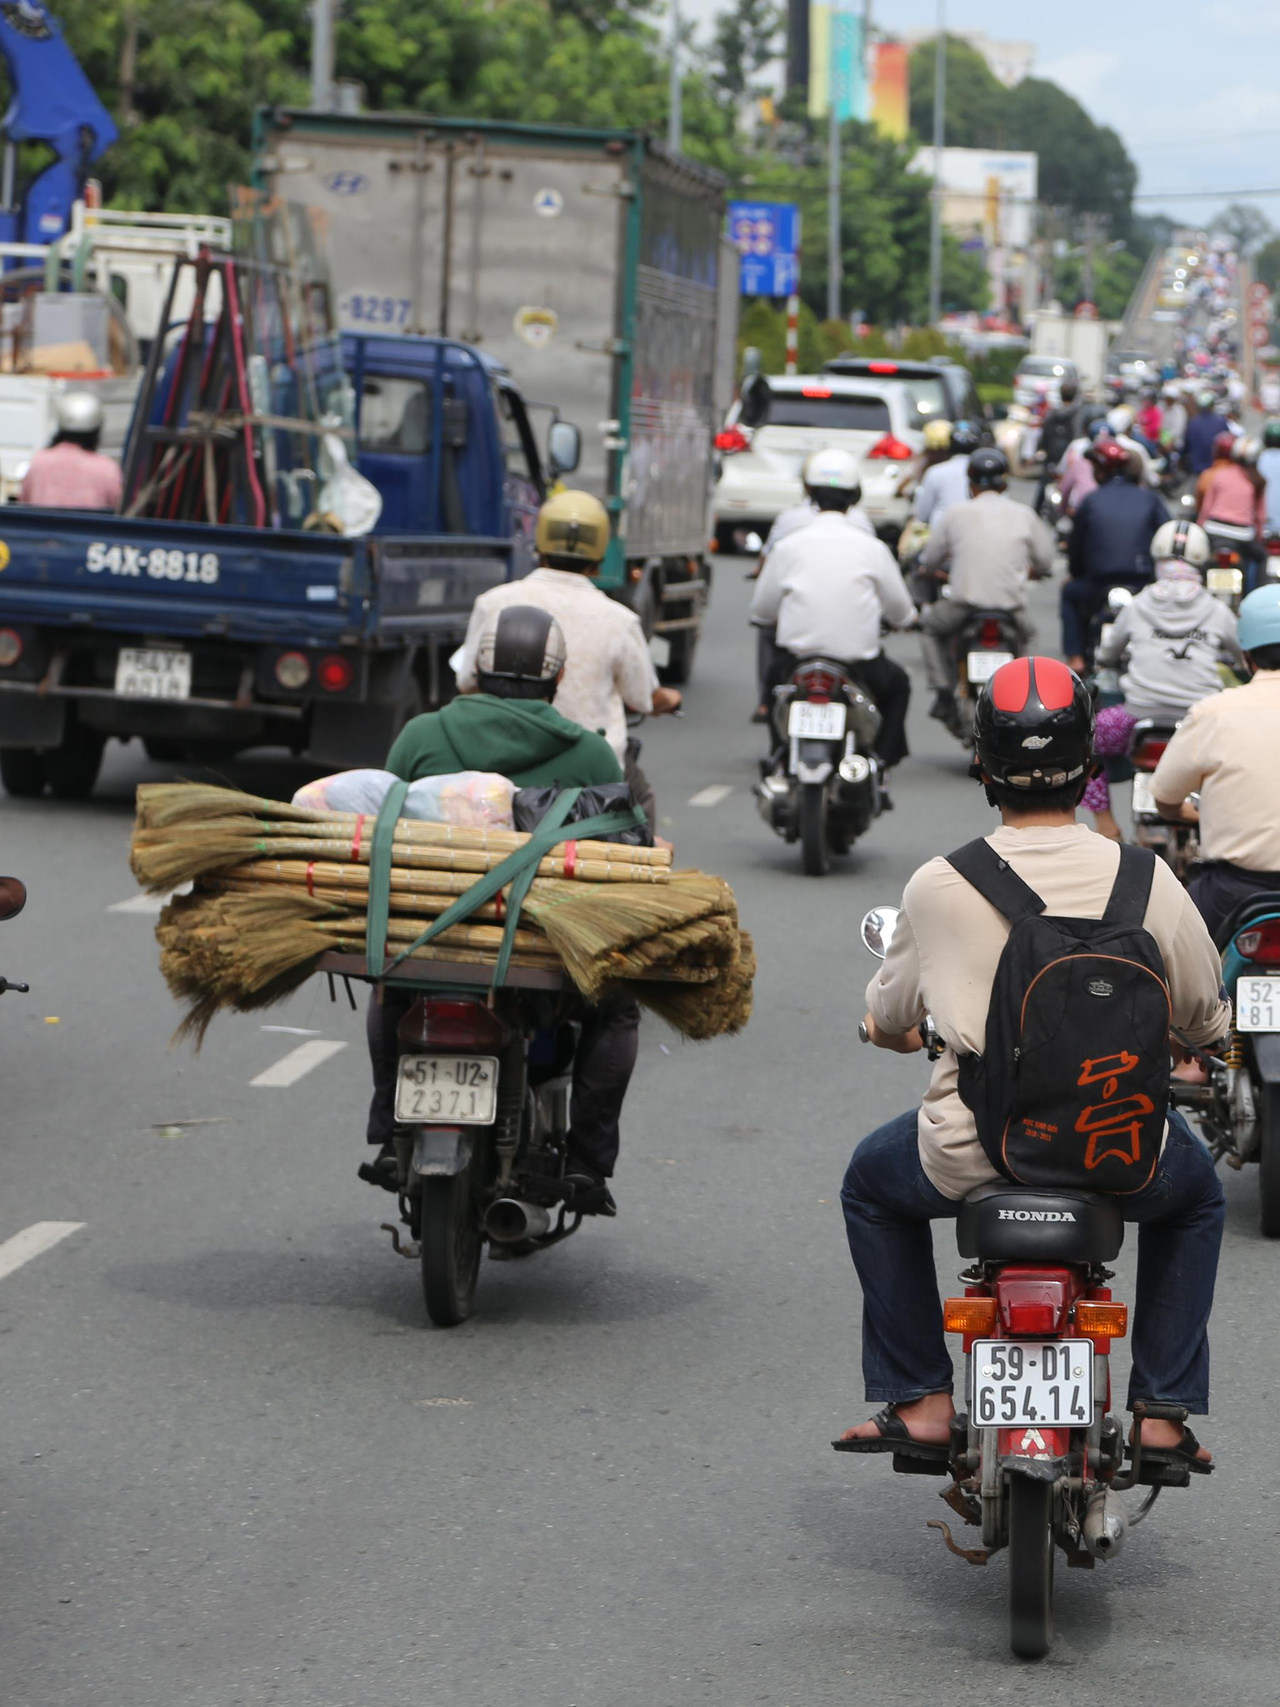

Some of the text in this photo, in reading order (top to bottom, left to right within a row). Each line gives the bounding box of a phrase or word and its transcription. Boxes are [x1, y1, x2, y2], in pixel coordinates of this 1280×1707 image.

[86, 542, 219, 584] 54X-8818
[414, 1060, 482, 1087] 51-U2
[411, 1089, 477, 1115] 2371
[998, 1209, 1077, 1222] HONDA
[979, 1385, 1086, 1421] 654.14
